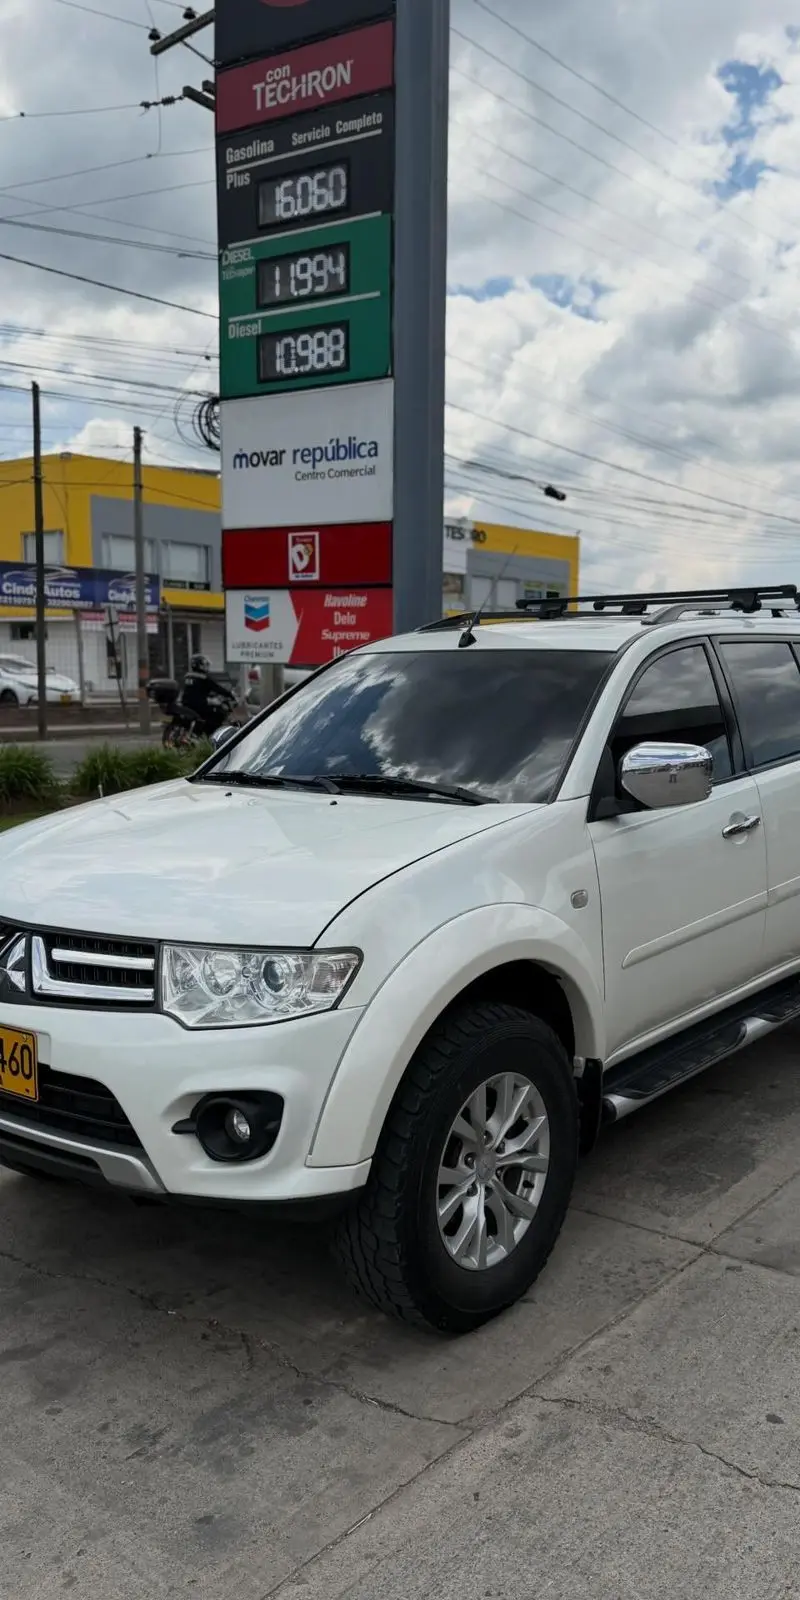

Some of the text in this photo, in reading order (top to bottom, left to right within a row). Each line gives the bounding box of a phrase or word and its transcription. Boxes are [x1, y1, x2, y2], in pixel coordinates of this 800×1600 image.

[266, 64, 290, 82] con
[252, 60, 353, 110] TECHRON
[226, 111, 383, 164] Gasolina Servicio Completo
[226, 171, 250, 189] Plus
[274, 167, 347, 219] 16.060
[221, 247, 255, 267] DIESEL
[228, 319, 262, 339] Diesel
[275, 328, 346, 374] 10.988
[233, 435, 379, 469] movar república
[294, 465, 377, 481] Centro Comercial
[2, 582, 37, 600] Cindy
[44, 585, 81, 599] Autos
[324, 594, 368, 608] Havoline
[333, 611, 357, 626] Delo
[321, 629, 371, 643] Supreme
